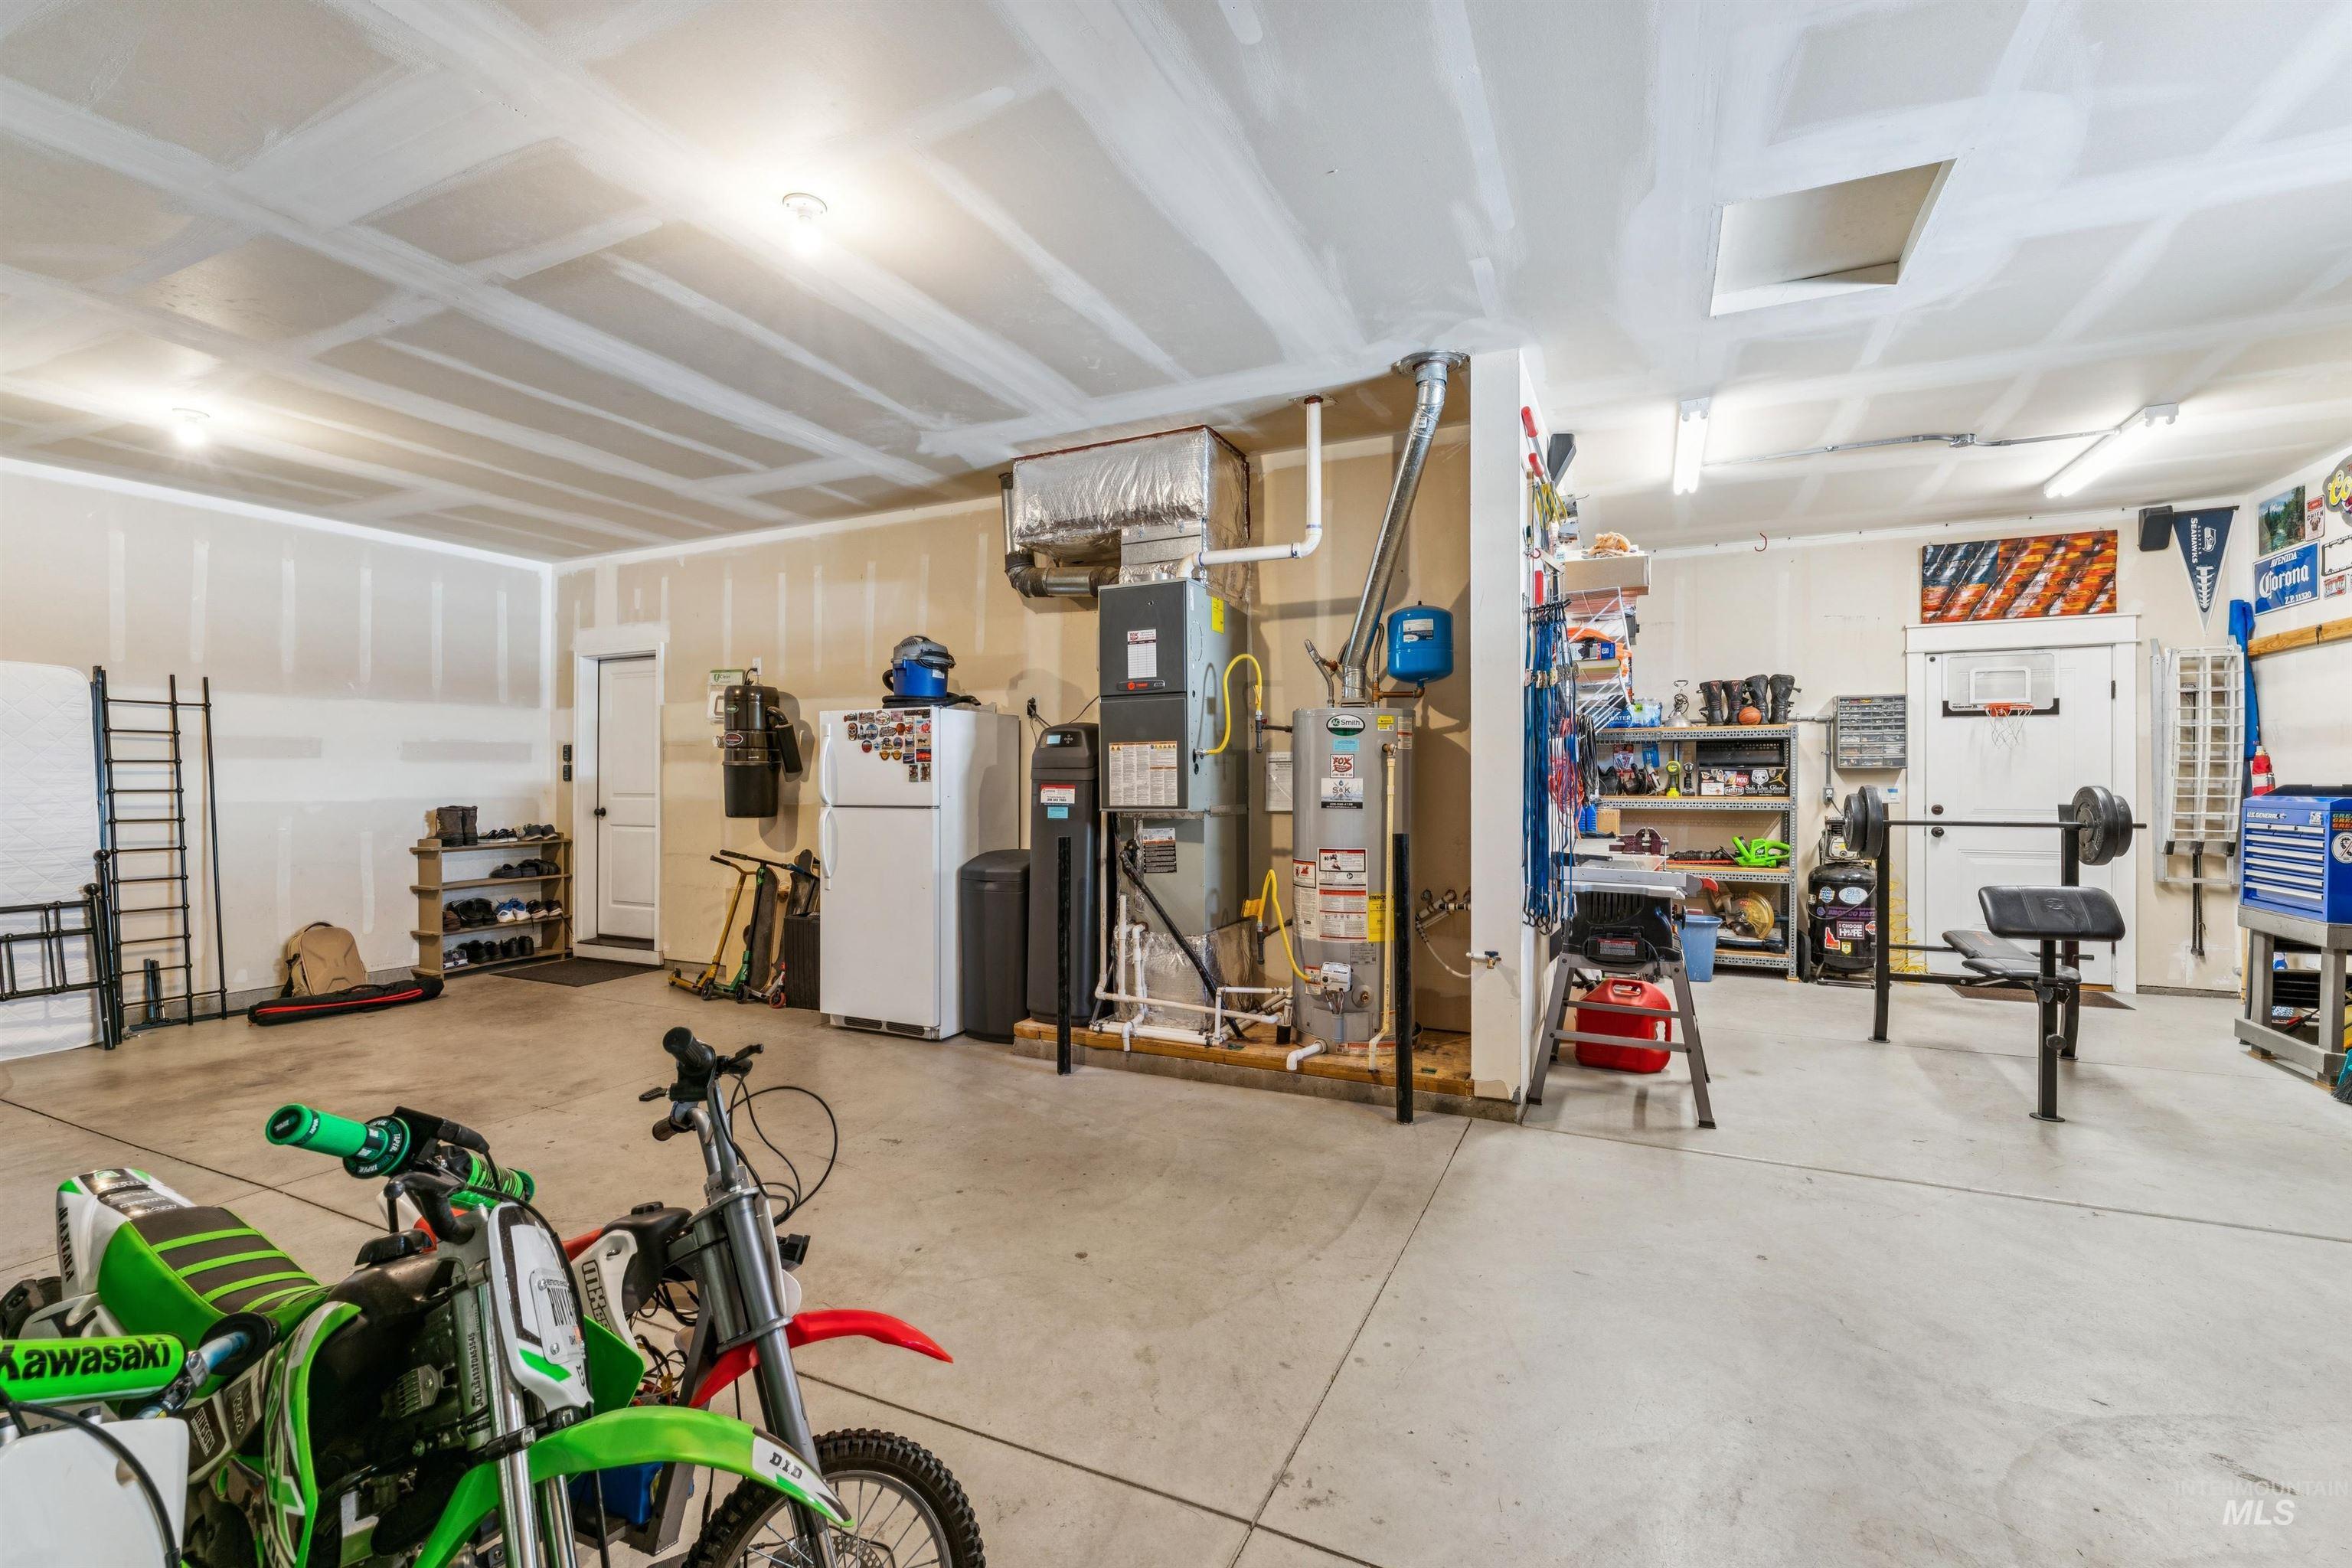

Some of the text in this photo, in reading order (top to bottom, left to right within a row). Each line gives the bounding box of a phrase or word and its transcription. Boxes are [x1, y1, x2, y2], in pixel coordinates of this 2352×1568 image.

[1945, 558, 1974, 570] 1776
[2269, 550, 2298, 568] AVENIDA
[2259, 564, 2310, 599] Corona
[1332, 756, 1354, 766] FOX
[0, 1337, 171, 1381] Kawasaki
